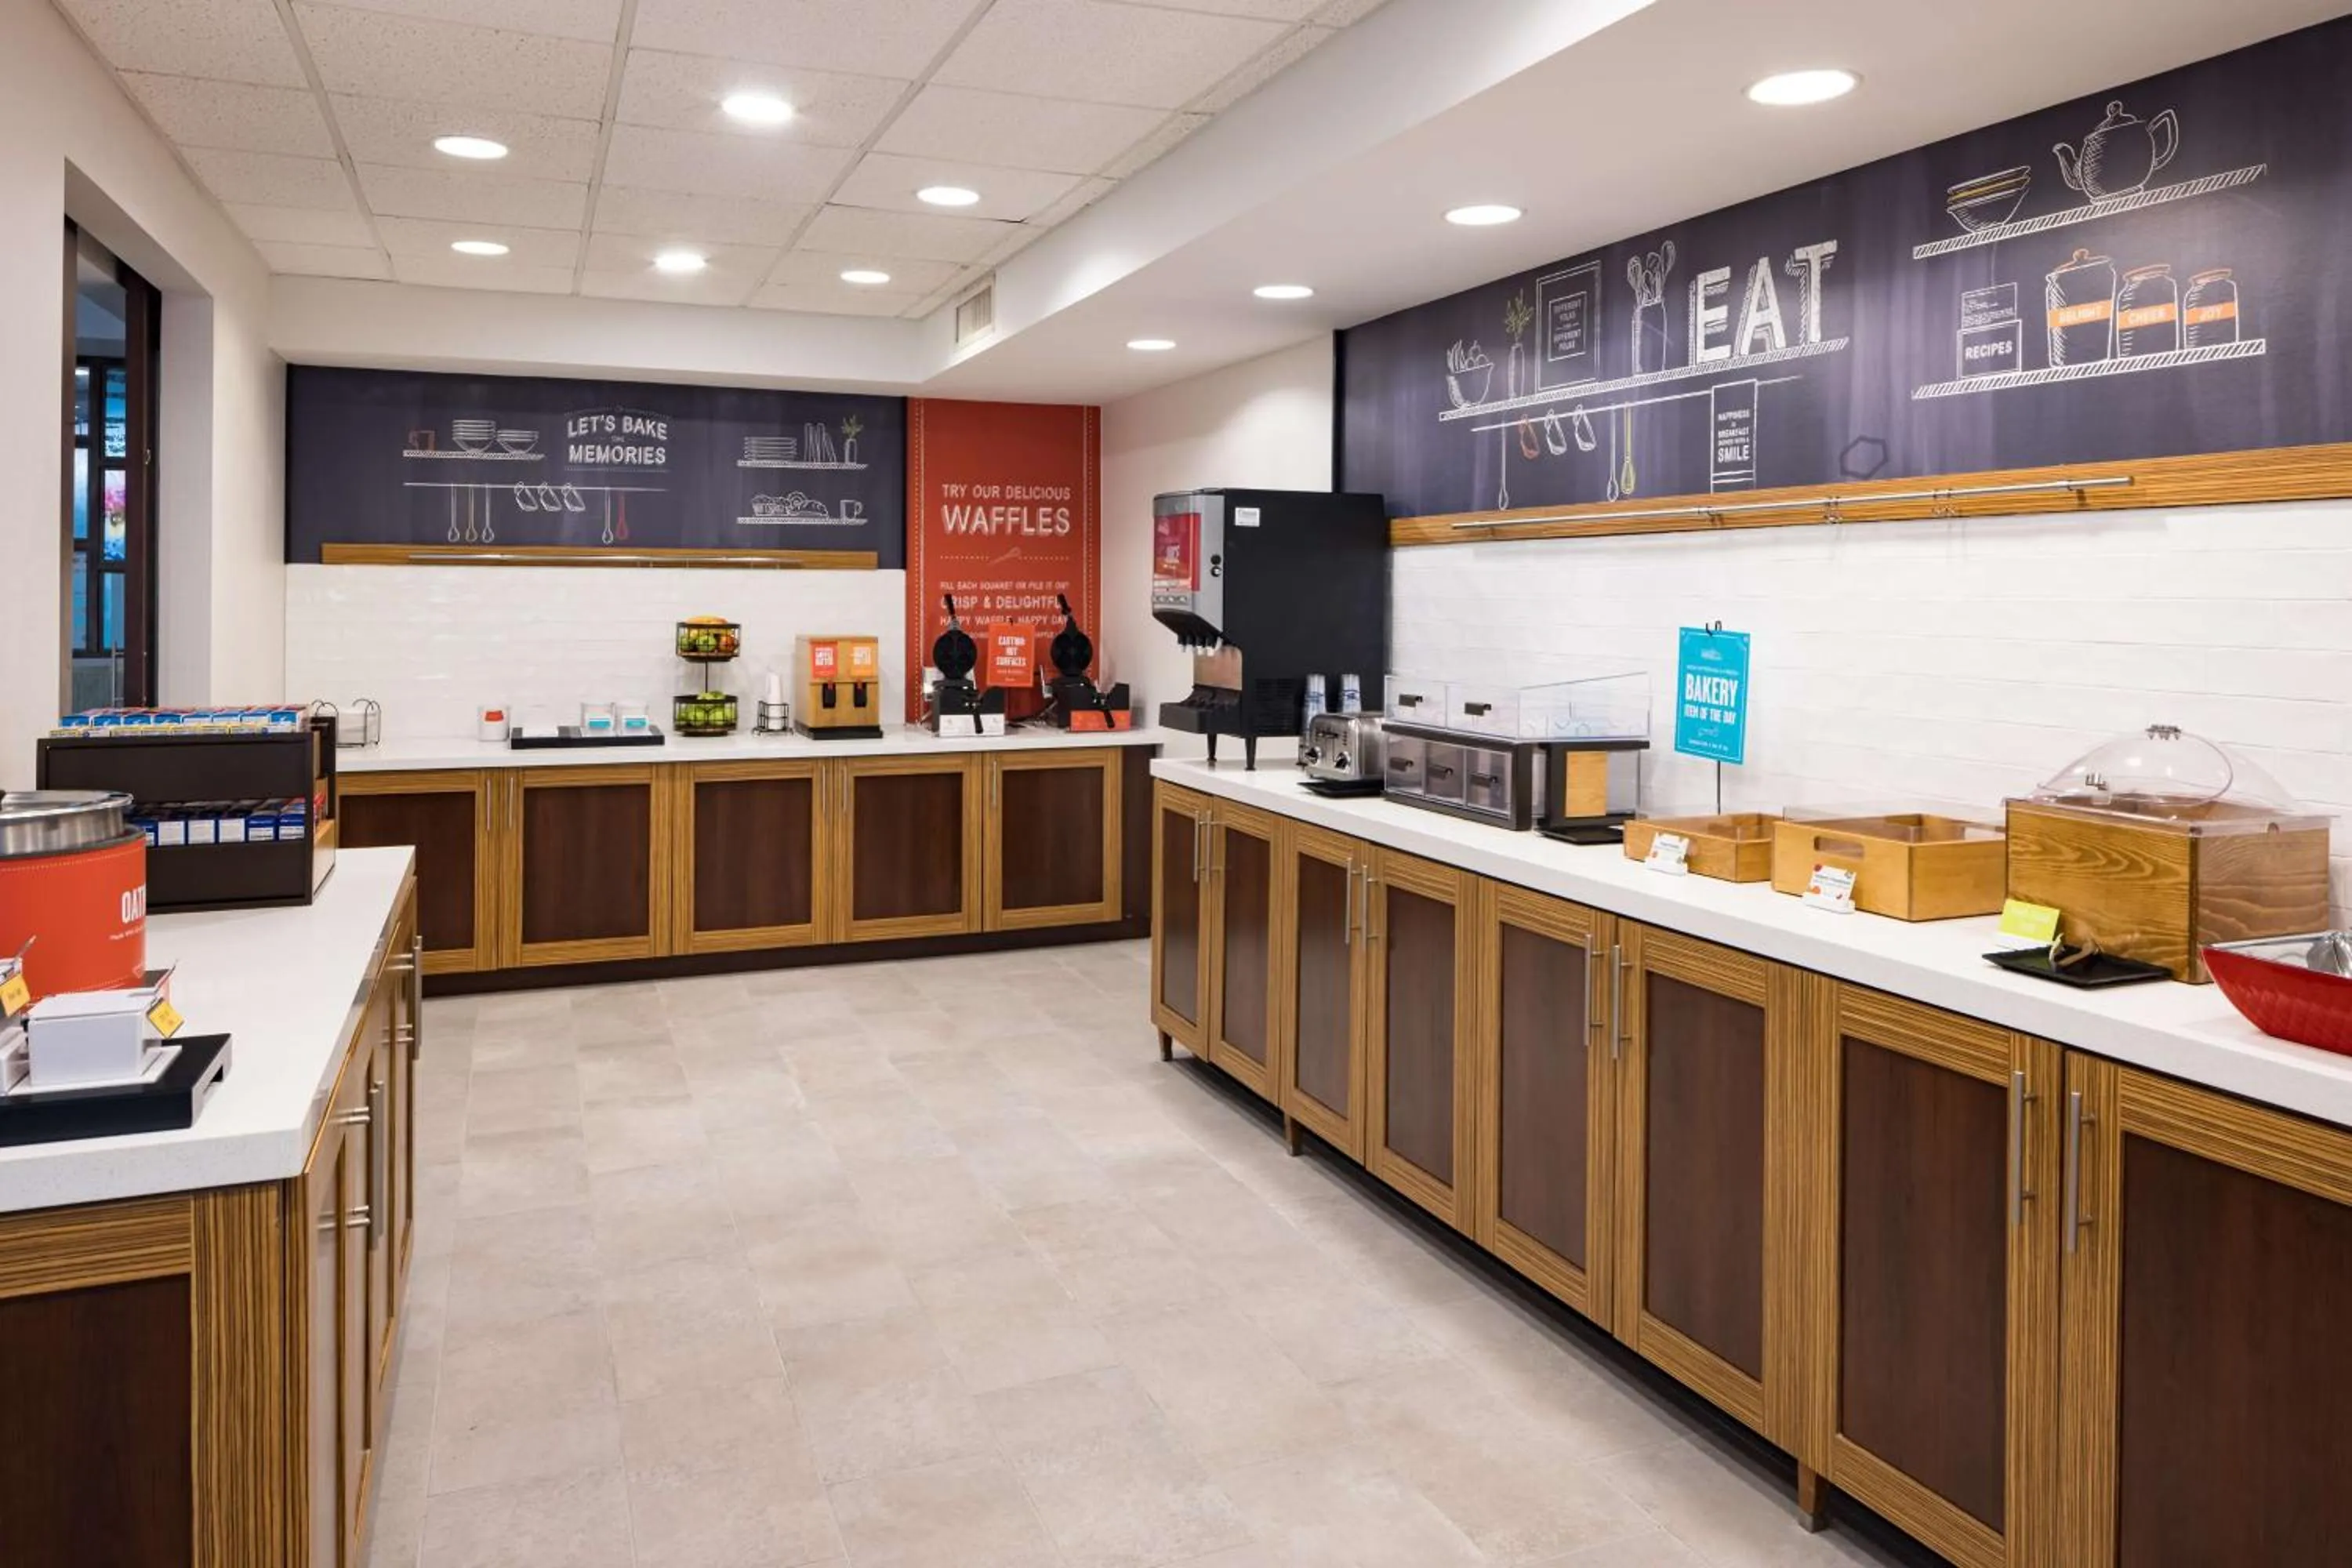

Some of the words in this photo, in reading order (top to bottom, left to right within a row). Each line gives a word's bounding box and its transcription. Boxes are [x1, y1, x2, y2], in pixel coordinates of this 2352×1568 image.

[1690, 239, 1838, 364] EAT
[1965, 340, 2013, 360] RECIPES
[567, 415, 616, 438] LET'S
[622, 415, 668, 441] BAKE
[568, 444, 666, 465] MEMORIES
[1718, 445, 1750, 463] SMILE
[942, 484, 967, 499] TRY
[973, 485, 1000, 499] OUR
[1006, 485, 1071, 500] DELICIOUS
[942, 504, 1070, 535] WAFFLES
[1685, 673, 1739, 708] BAKERY
[1710, 708, 1722, 723] THE
